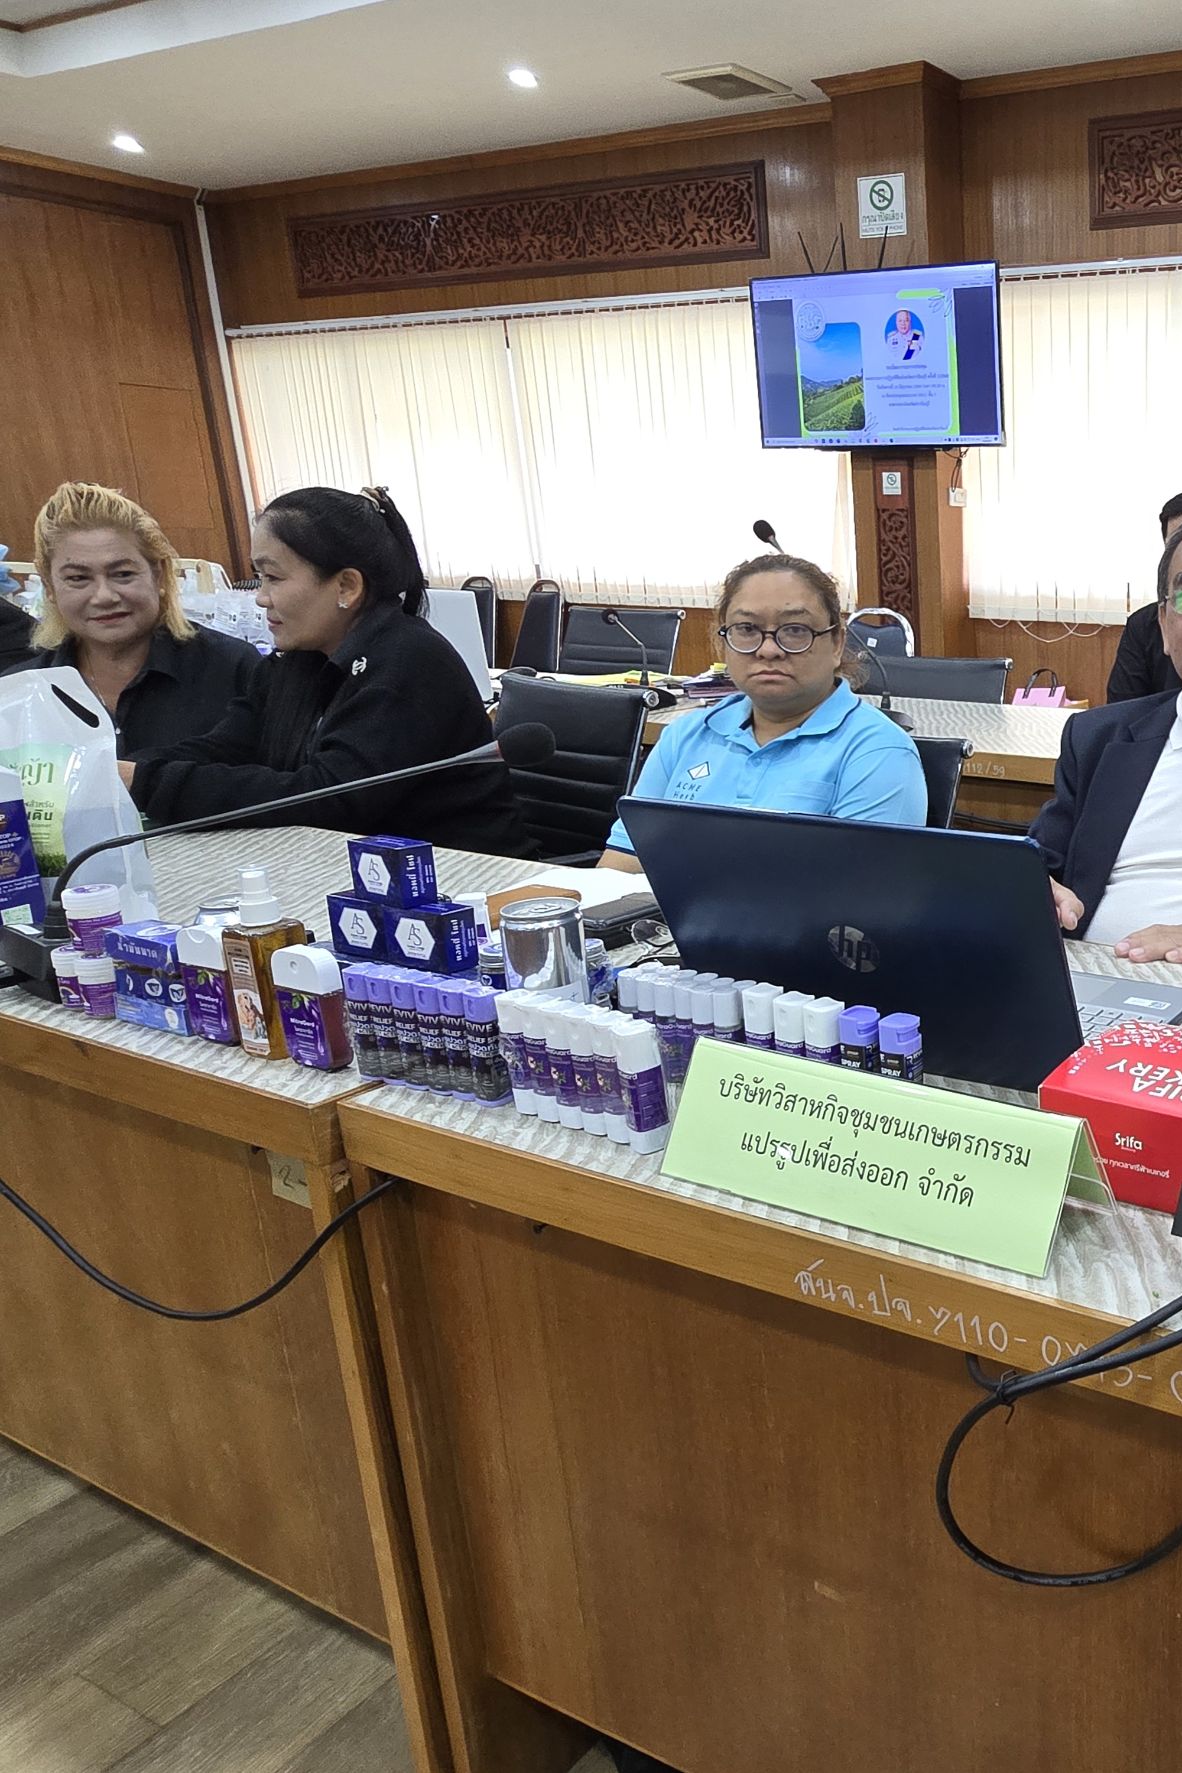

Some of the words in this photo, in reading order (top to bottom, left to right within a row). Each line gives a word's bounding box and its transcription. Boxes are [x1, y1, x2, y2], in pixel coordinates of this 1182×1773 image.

[719, 1072, 1031, 1169] บริษัทวิสาหกิจชุมชนเกษตรกรรม
[1115, 1132, 1143, 1151] Srifa
[740, 1129, 909, 1192] แปรรูปเพื่อส่งออก
[918, 1166, 975, 1208] จำกัด
